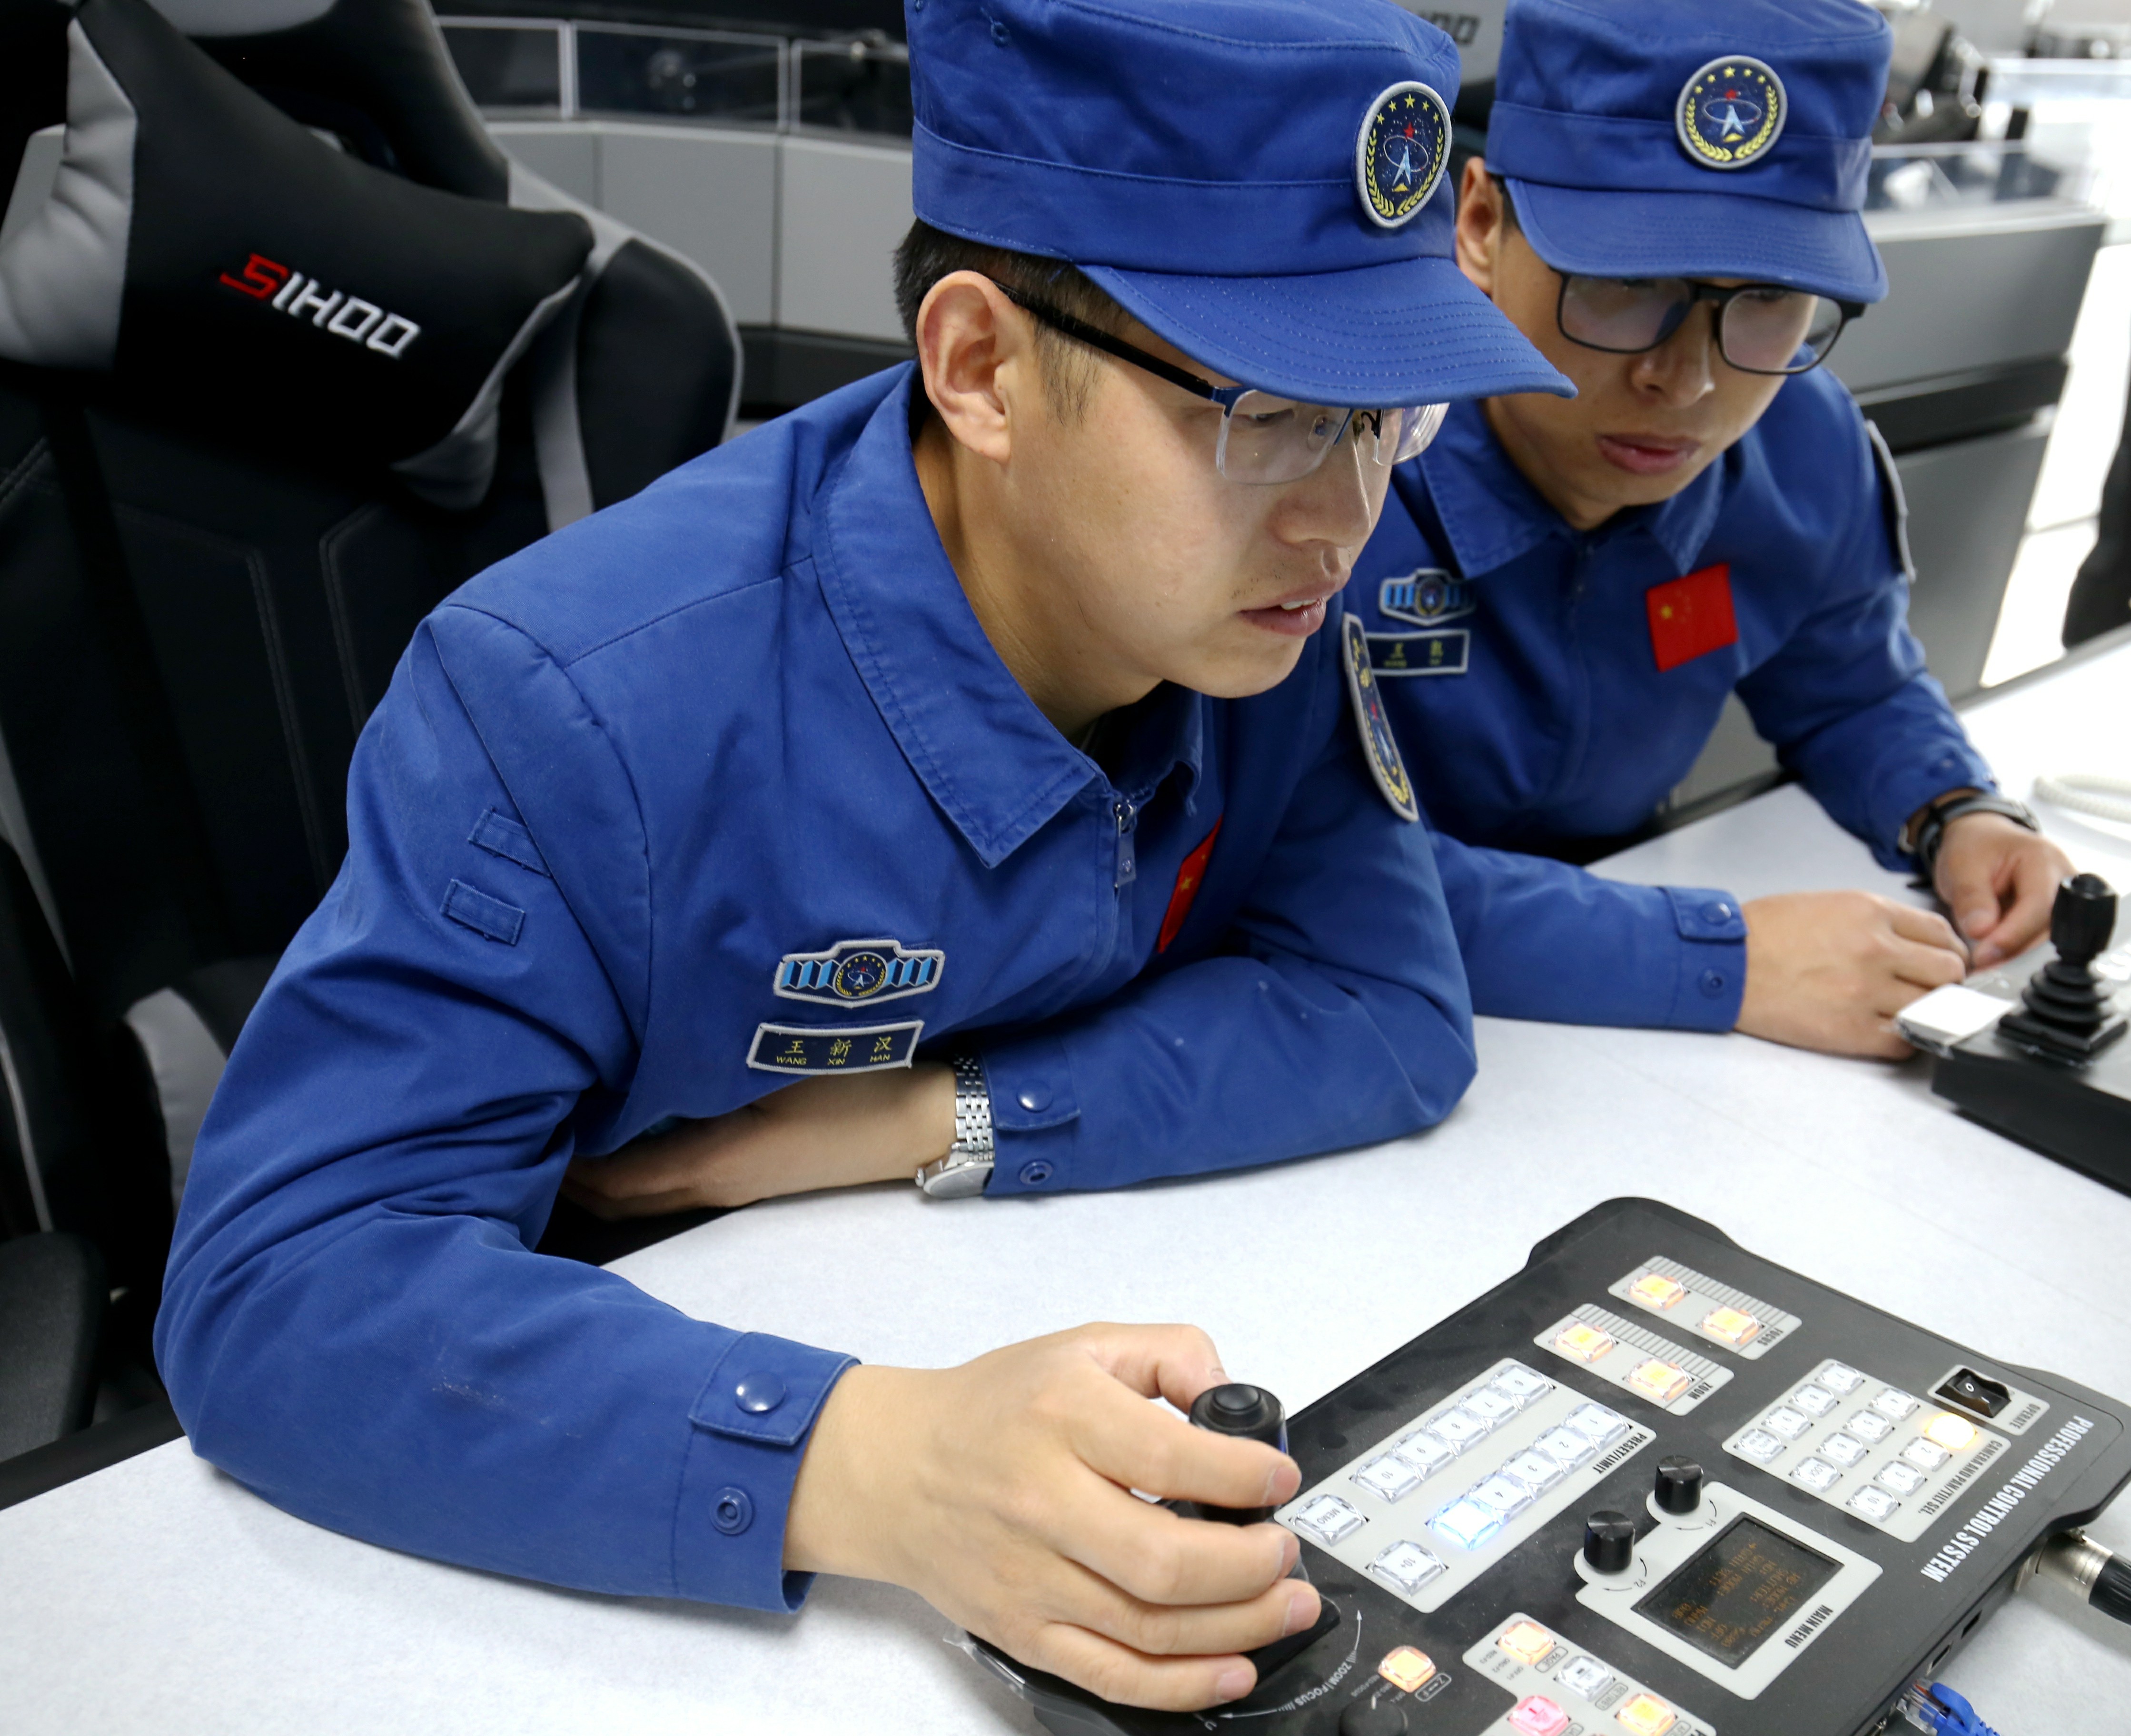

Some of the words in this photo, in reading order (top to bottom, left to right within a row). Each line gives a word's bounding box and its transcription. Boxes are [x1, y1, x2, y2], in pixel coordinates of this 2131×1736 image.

[219, 252, 421, 359] SIHOO
[785, 1036, 892, 1057] 王新汉
[776, 1055, 807, 1065] WANG
[869, 1054, 891, 1063] HAN
[1757, 1327, 1784, 1346] FOCUS
[1687, 1382, 1714, 1401] ZOOM
[2009, 1403, 2041, 1429] OPERATE
[1592, 1432, 1647, 1475] PRESET/LIMIT
[1971, 1440, 2003, 1466] CAMERA
[2010, 1415, 2094, 1490] PROFESSIONAL
[1381, 1470, 1394, 1480] 10
[1808, 1463, 1826, 1476] LOCK
[1958, 1462, 1979, 1478] AND
[1932, 1475, 1967, 1504] PAN/TILT
[1867, 1496, 1880, 1505] 10
[1963, 1483, 2026, 1538] CONTROL
[1317, 1508, 1341, 1524] MEMO
[1400, 1557, 1417, 1568] 10+
[1920, 1531, 1980, 1583] SYSTEM
[1634, 1579, 1647, 1588] F2
[1805, 1605, 1834, 1628] MAIN
[1784, 1624, 1814, 1648] MENU
